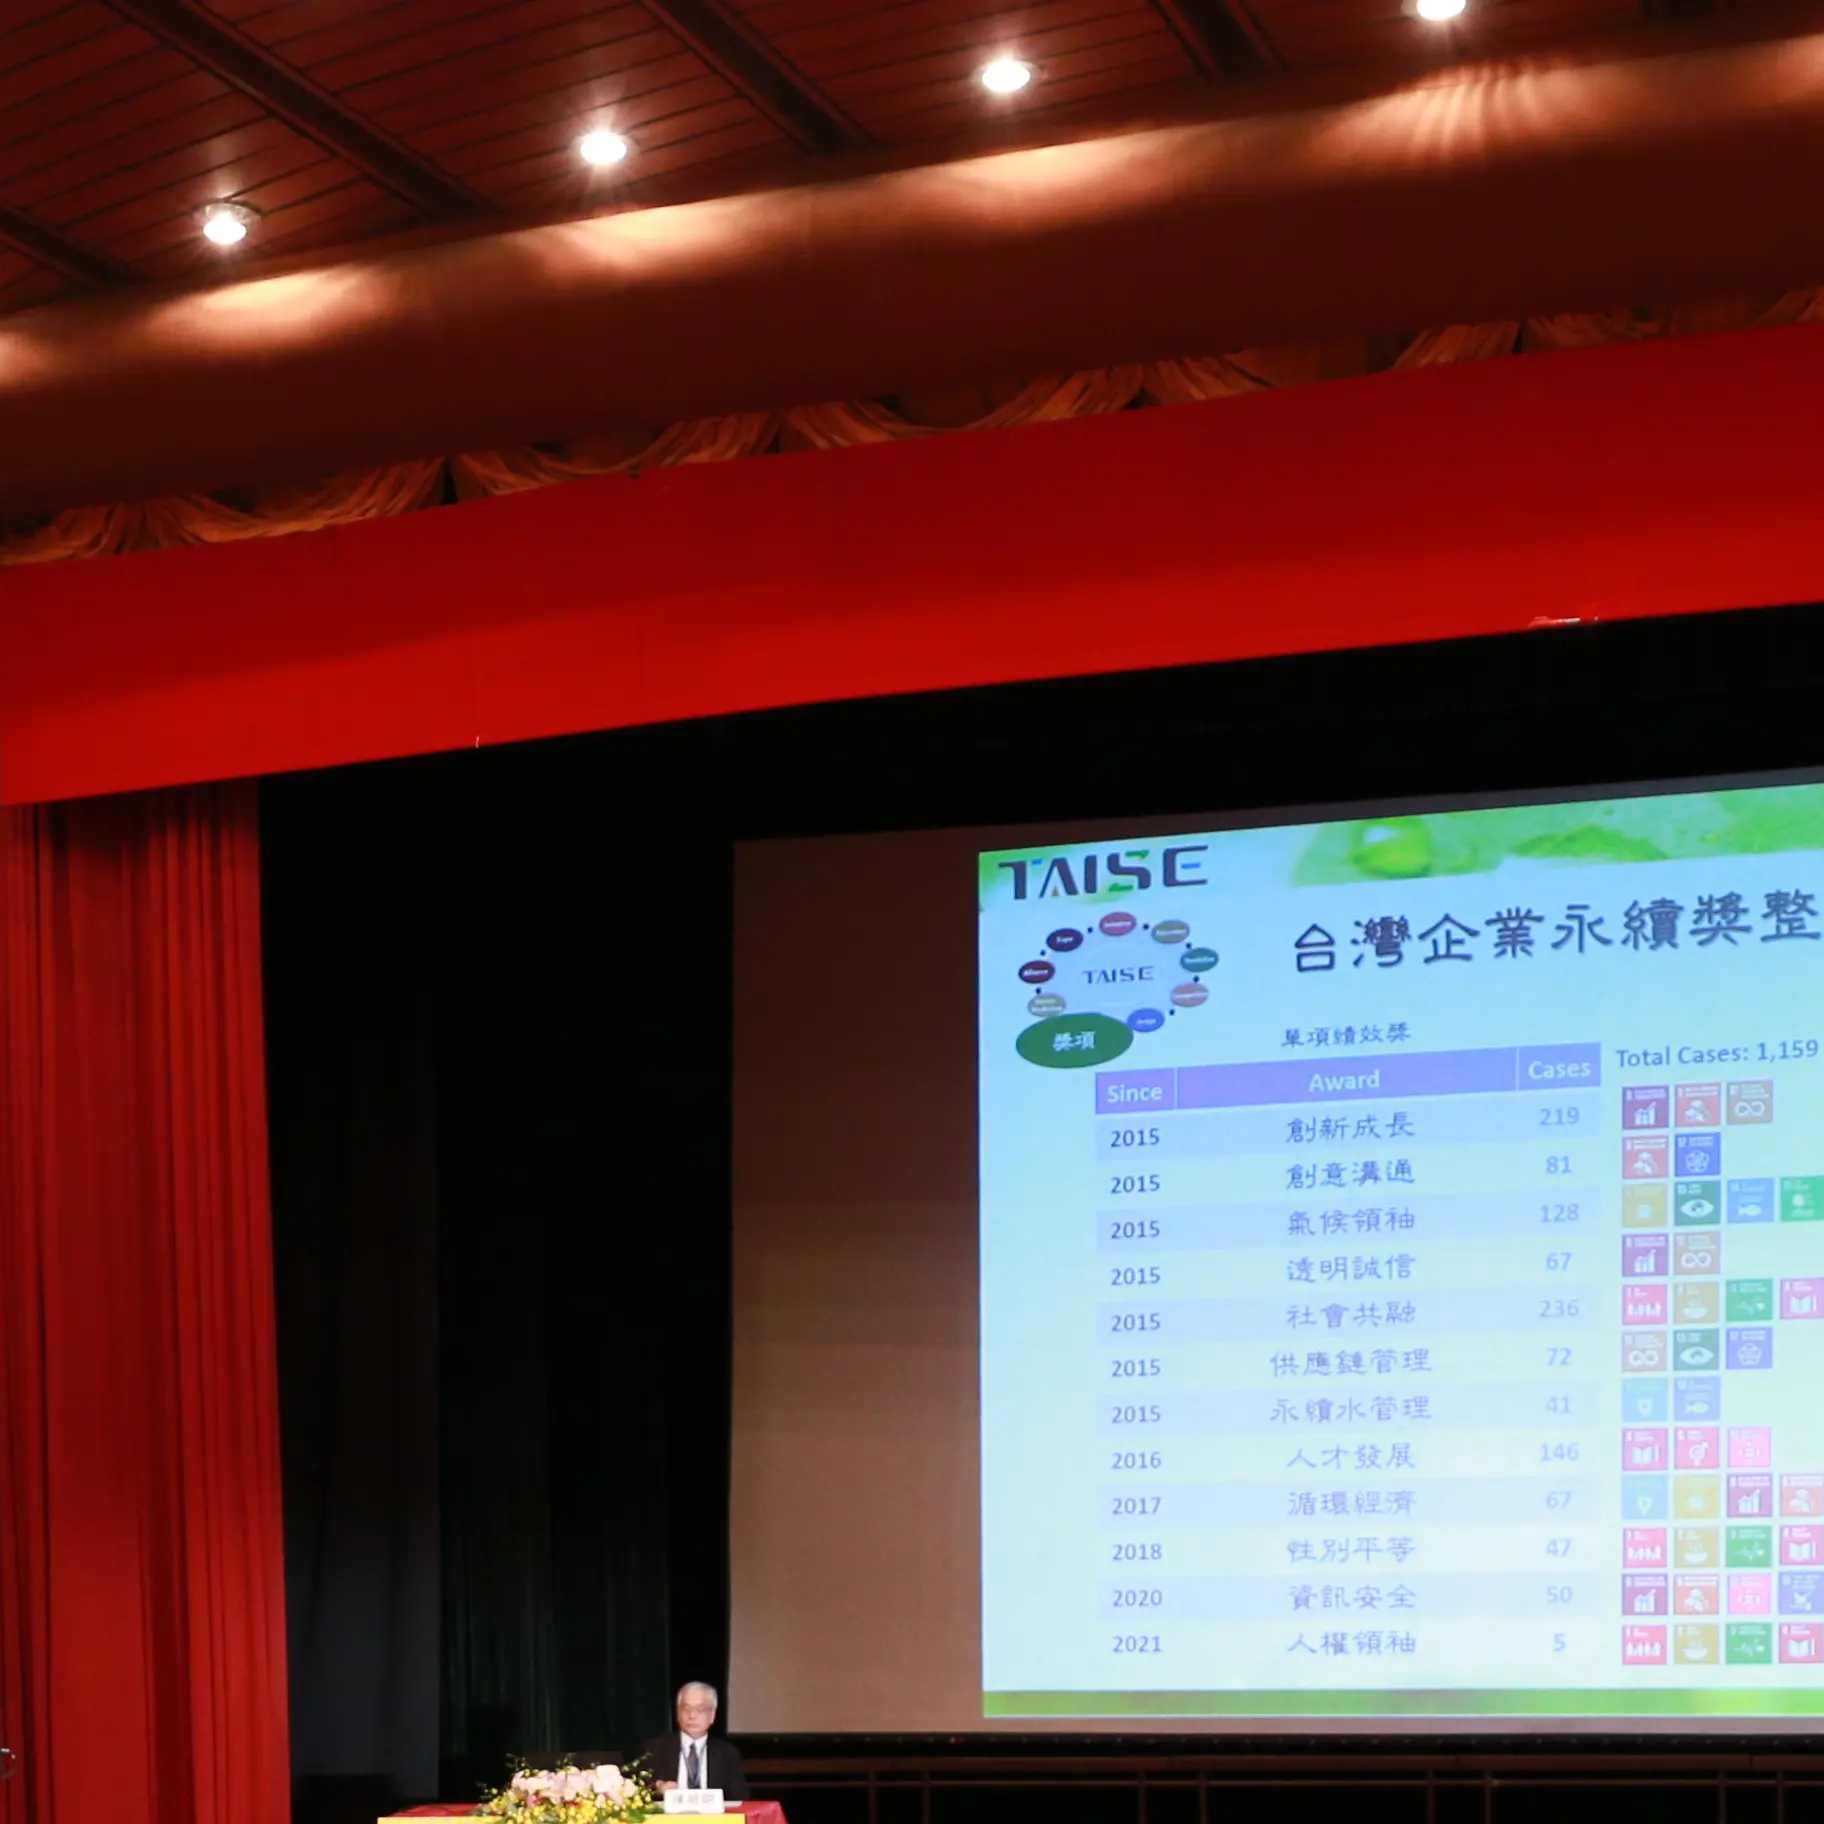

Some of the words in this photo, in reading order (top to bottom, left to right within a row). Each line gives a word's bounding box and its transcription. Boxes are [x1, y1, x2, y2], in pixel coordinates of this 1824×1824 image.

[998, 844, 1209, 901] TAISE
[1082, 966, 1154, 984] TAISE
[1616, 1046, 1672, 1070] Total
[1677, 1044, 1751, 1067] Cases:
[1756, 1038, 1820, 1064] 1,159
[1106, 1081, 1164, 1105] Since
[1308, 1069, 1380, 1094] Award
[1528, 1059, 1592, 1081] Cases
[1110, 1127, 1162, 1148] 2015
[1284, 1112, 1417, 1144] 創新成長
[1538, 1106, 1581, 1127] 219
[1110, 1173, 1162, 1194] 2015
[1284, 1159, 1417, 1190] 創意溝通
[1544, 1156, 1573, 1174] 81
[1110, 1219, 1162, 1240] 2015
[1286, 1206, 1417, 1237] 氣候領袖
[1539, 1203, 1581, 1223] 128
[1110, 1266, 1163, 1287] 2015
[1286, 1255, 1417, 1284] 透明誠信
[1544, 1252, 1574, 1272] 67
[1110, 1312, 1163, 1333] 2015
[1285, 1301, 1417, 1331] 社會共融
[1538, 1298, 1580, 1319] 236
[1110, 1358, 1163, 1379] 2015
[1268, 1347, 1433, 1377] 供應鏈管理
[1544, 1347, 1574, 1367] 72
[1110, 1404, 1163, 1425] 2015
[1268, 1394, 1433, 1424] 永續水管理
[1544, 1395, 1573, 1415] 41
[1110, 1451, 1163, 1471] 2016
[1286, 1442, 1417, 1472] 人才發展
[1538, 1442, 1581, 1463] 146
[1111, 1496, 1163, 1517] 2017
[1286, 1489, 1417, 1519] 循環經濟
[1544, 1490, 1574, 1511] 67
[1111, 1542, 1163, 1563] 2018
[1287, 1536, 1417, 1565] 性別平等
[1544, 1538, 1574, 1558] 47
[1111, 1588, 1164, 1609] 2020
[1287, 1582, 1417, 1612] 資訊安全
[1544, 1585, 1574, 1605] 50
[1111, 1634, 1164, 1655] 2021
[1287, 1629, 1417, 1658] 人權領袖
[1553, 1634, 1567, 1654] 5
